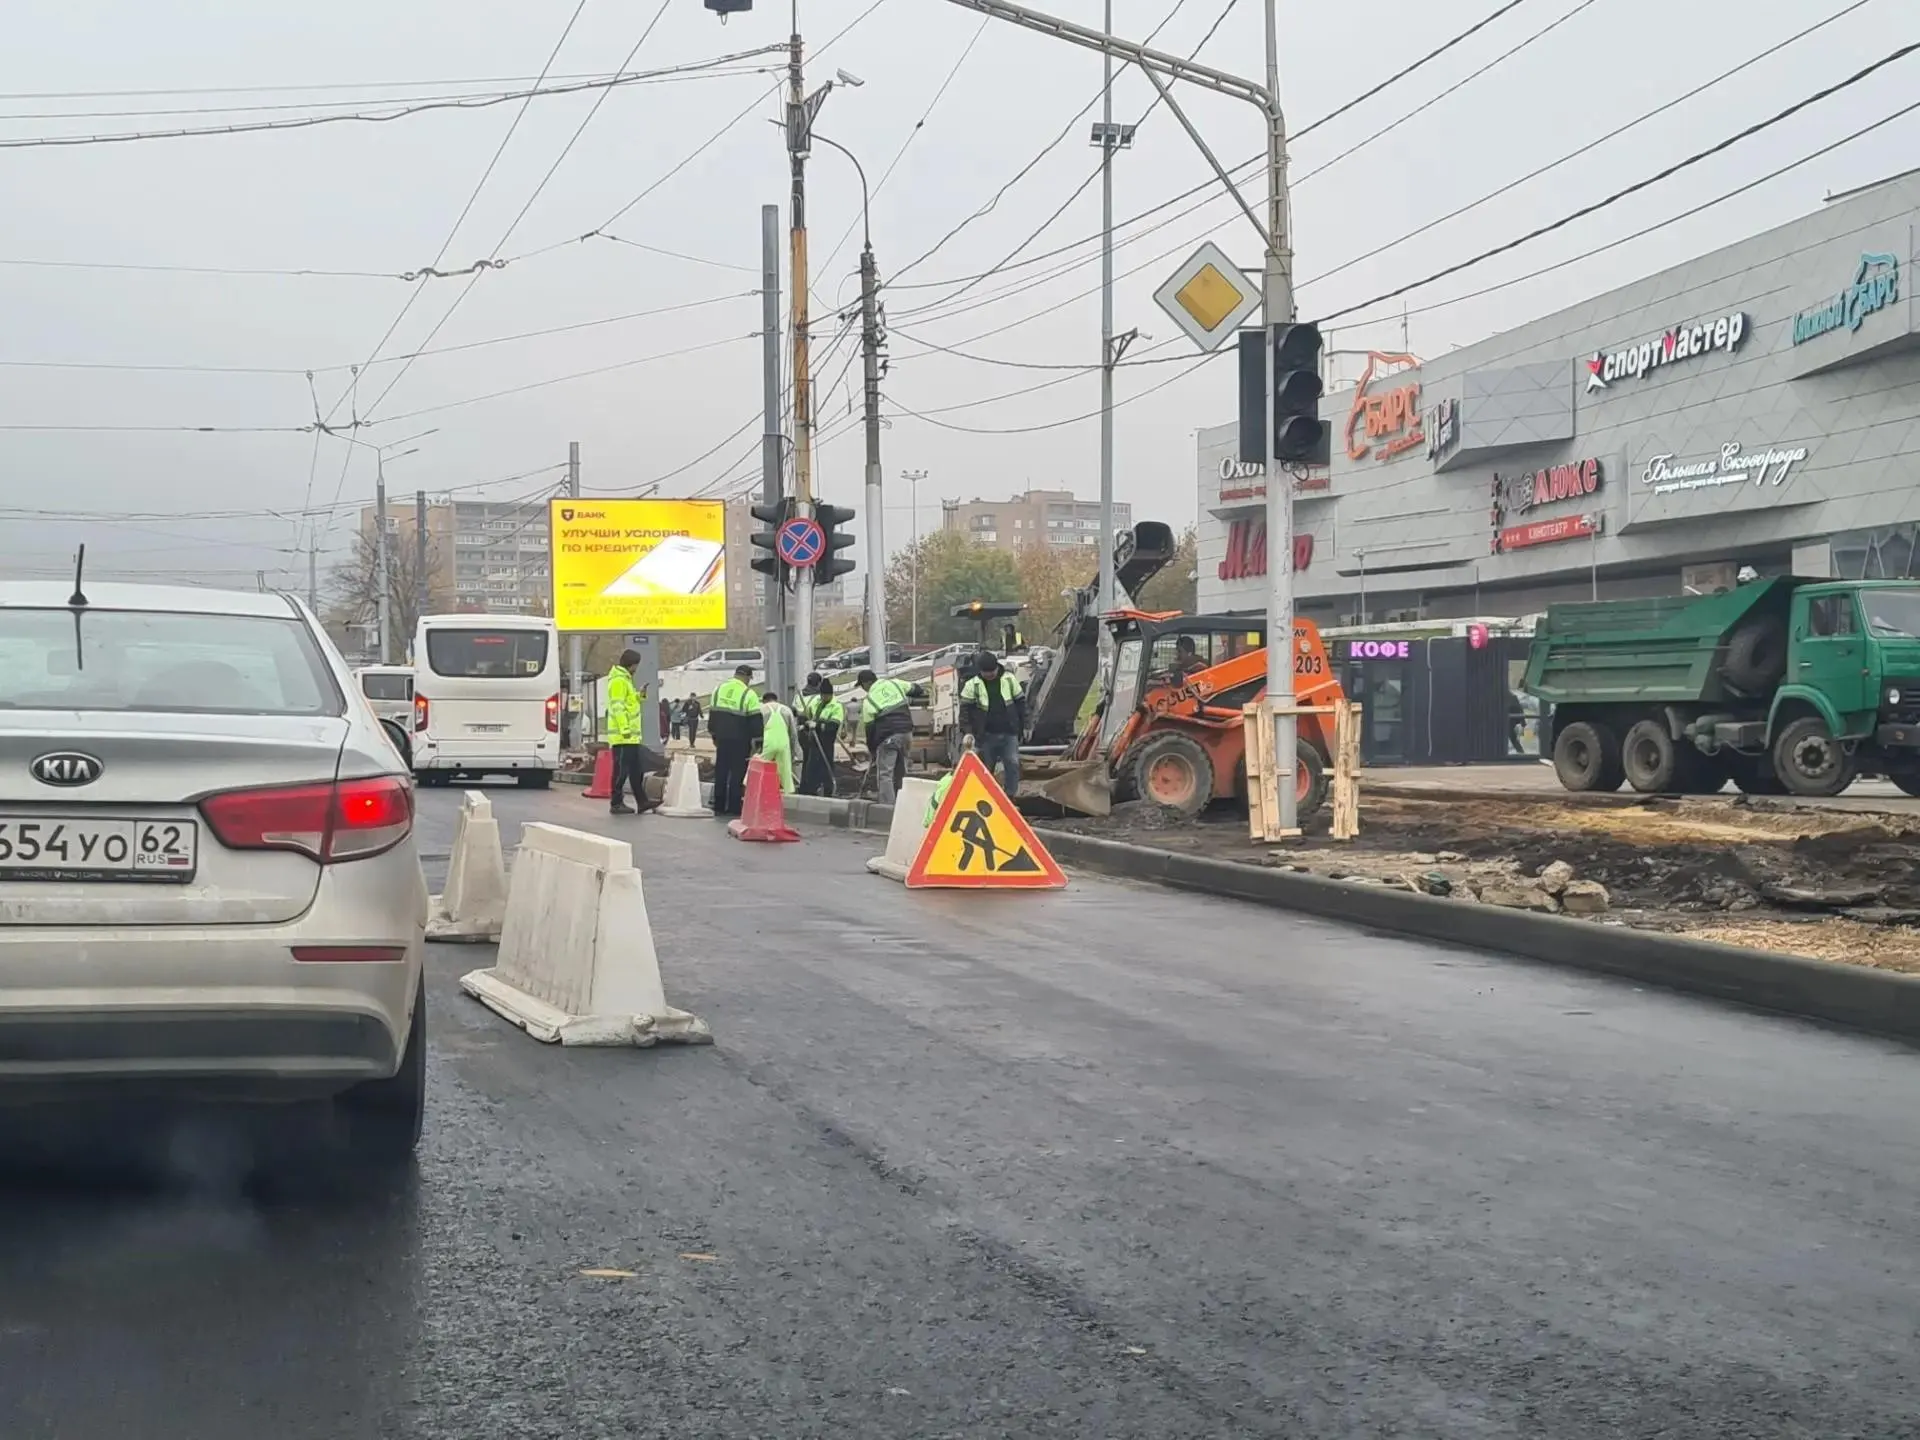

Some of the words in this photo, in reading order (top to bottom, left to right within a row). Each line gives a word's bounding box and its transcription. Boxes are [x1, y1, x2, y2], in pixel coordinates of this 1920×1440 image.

[1641, 452, 1718, 484] Большая
[1720, 441, 1808, 487] Сковорода
[561, 529, 621, 538] УЛУЧШИ
[1528, 521, 1568, 540] КИНОТЕАТР
[561, 544, 581, 553] ПО
[1350, 641, 1409, 657] КОФЕ
[1296, 656, 1322, 674] 203
[42, 760, 91, 780] KIA
[140, 825, 180, 854] 62
[136, 853, 167, 865] RUS
